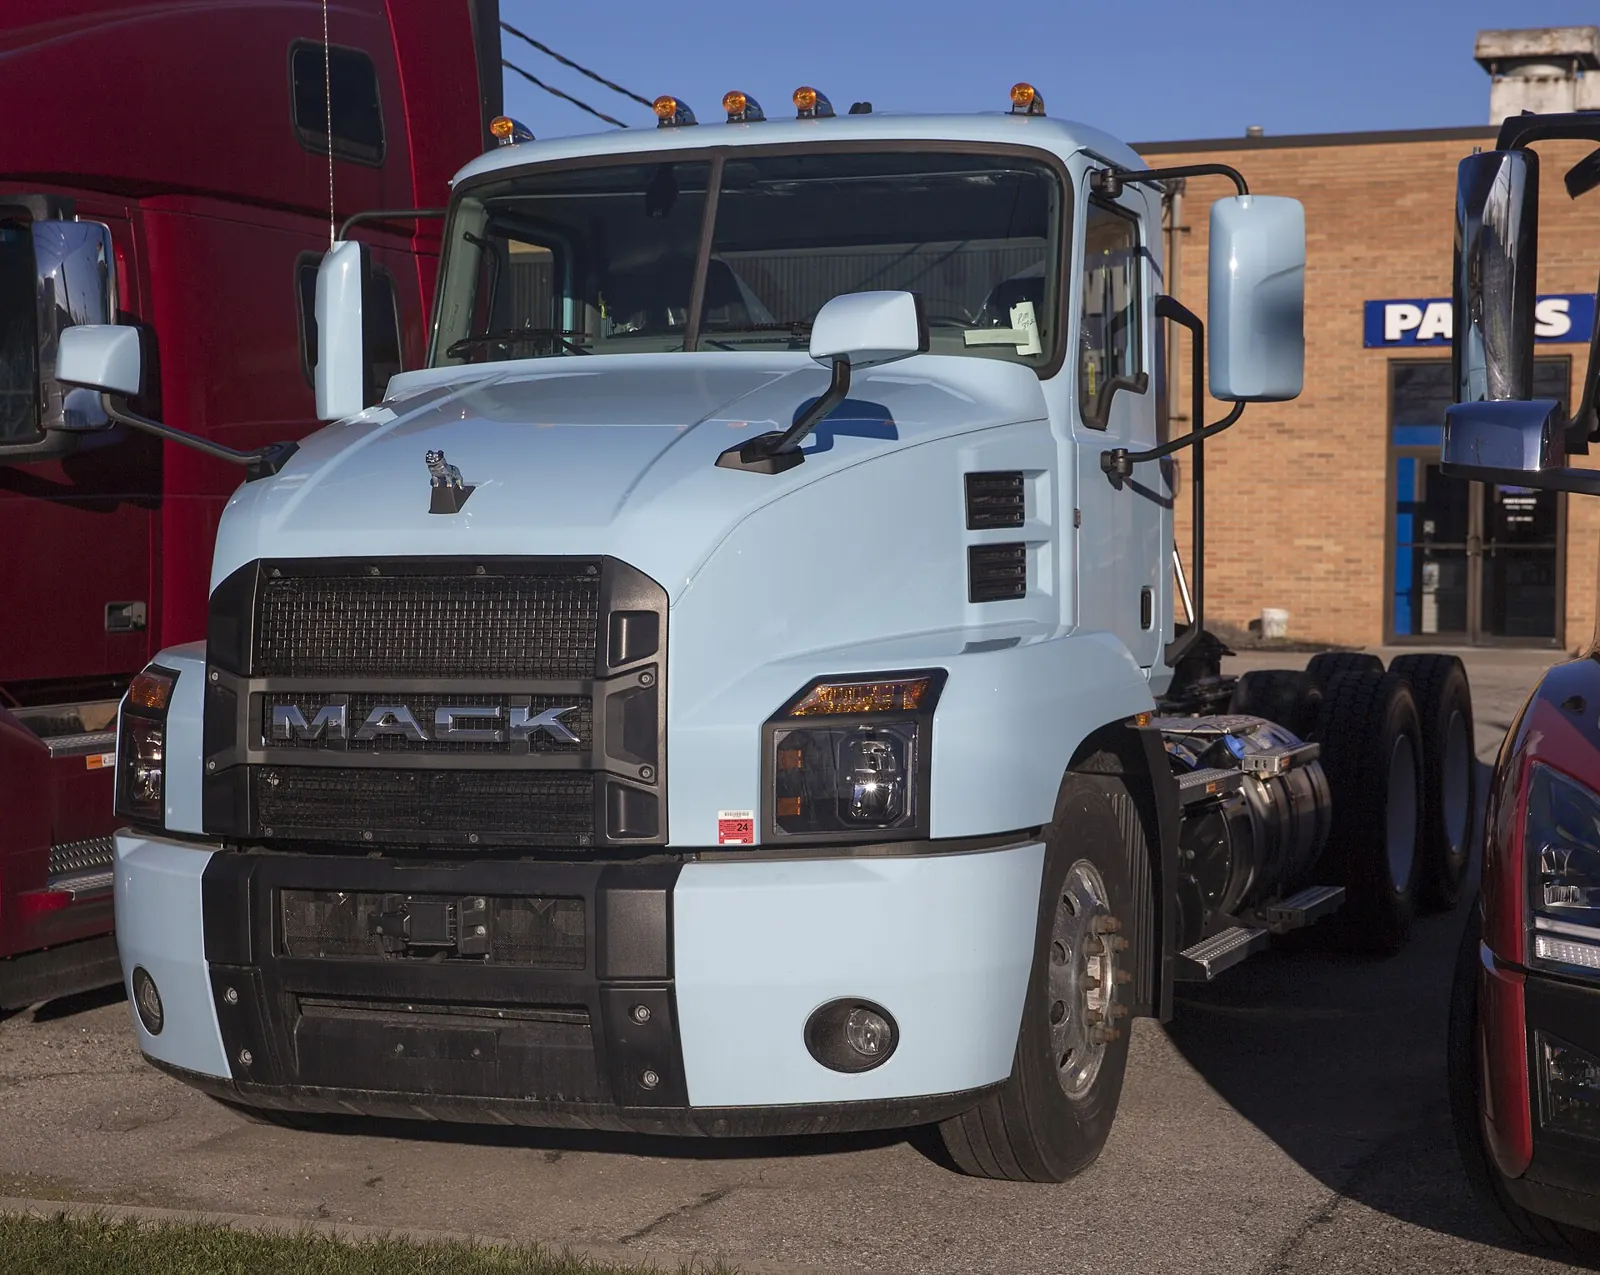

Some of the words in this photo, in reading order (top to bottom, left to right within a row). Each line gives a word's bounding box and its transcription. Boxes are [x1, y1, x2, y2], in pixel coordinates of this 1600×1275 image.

[1385, 299, 1571, 340] PAS
[273, 704, 580, 742] MACK
[737, 823, 748, 831] 24
